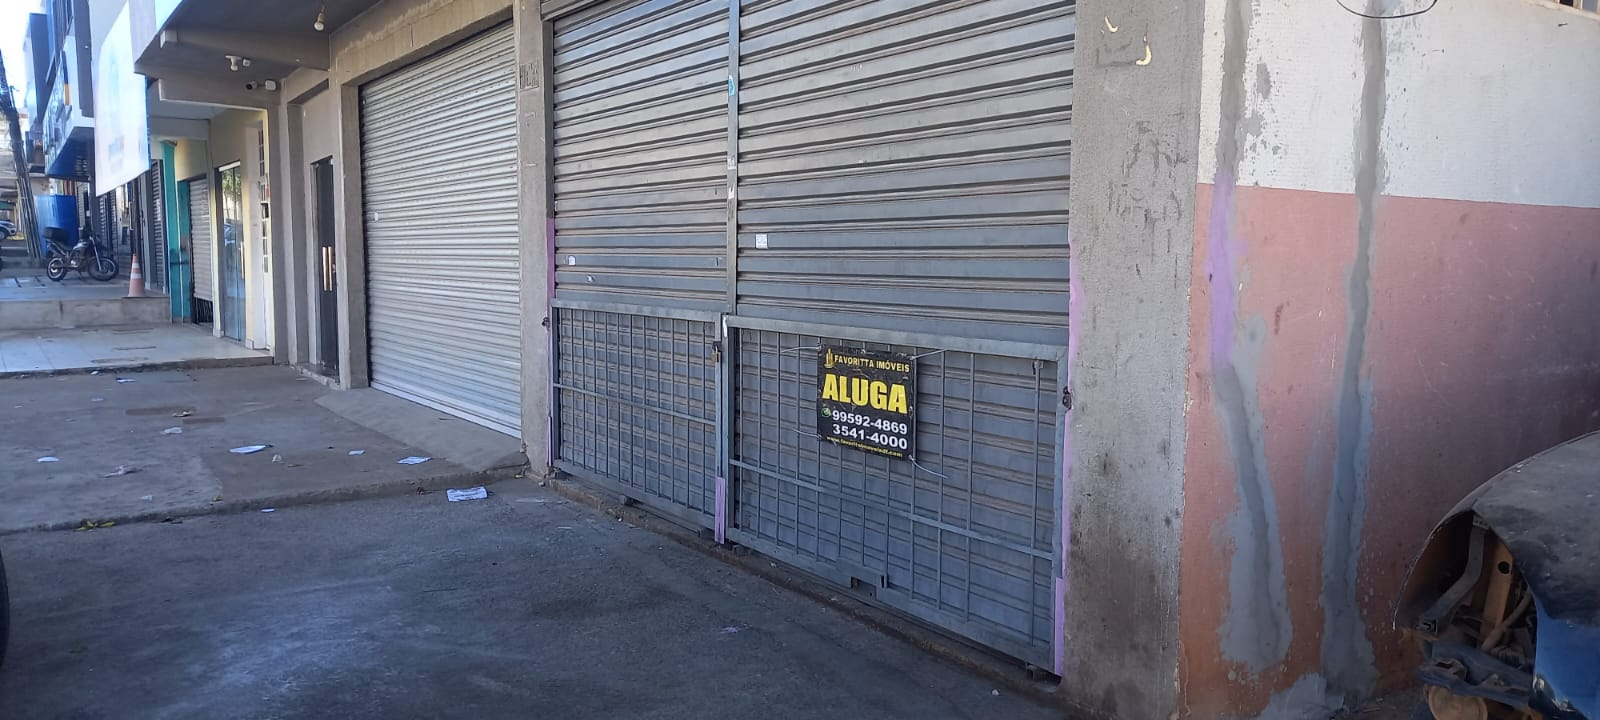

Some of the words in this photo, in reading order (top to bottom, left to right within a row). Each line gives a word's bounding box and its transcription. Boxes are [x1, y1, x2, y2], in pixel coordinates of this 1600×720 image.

[834, 355, 875, 368] FAVORITTA
[876, 359, 910, 373] IMÓVEIS
[822, 374, 908, 414] ALUGA
[832, 410, 908, 435] 99592-4869
[832, 424, 908, 450] 3541-4000
